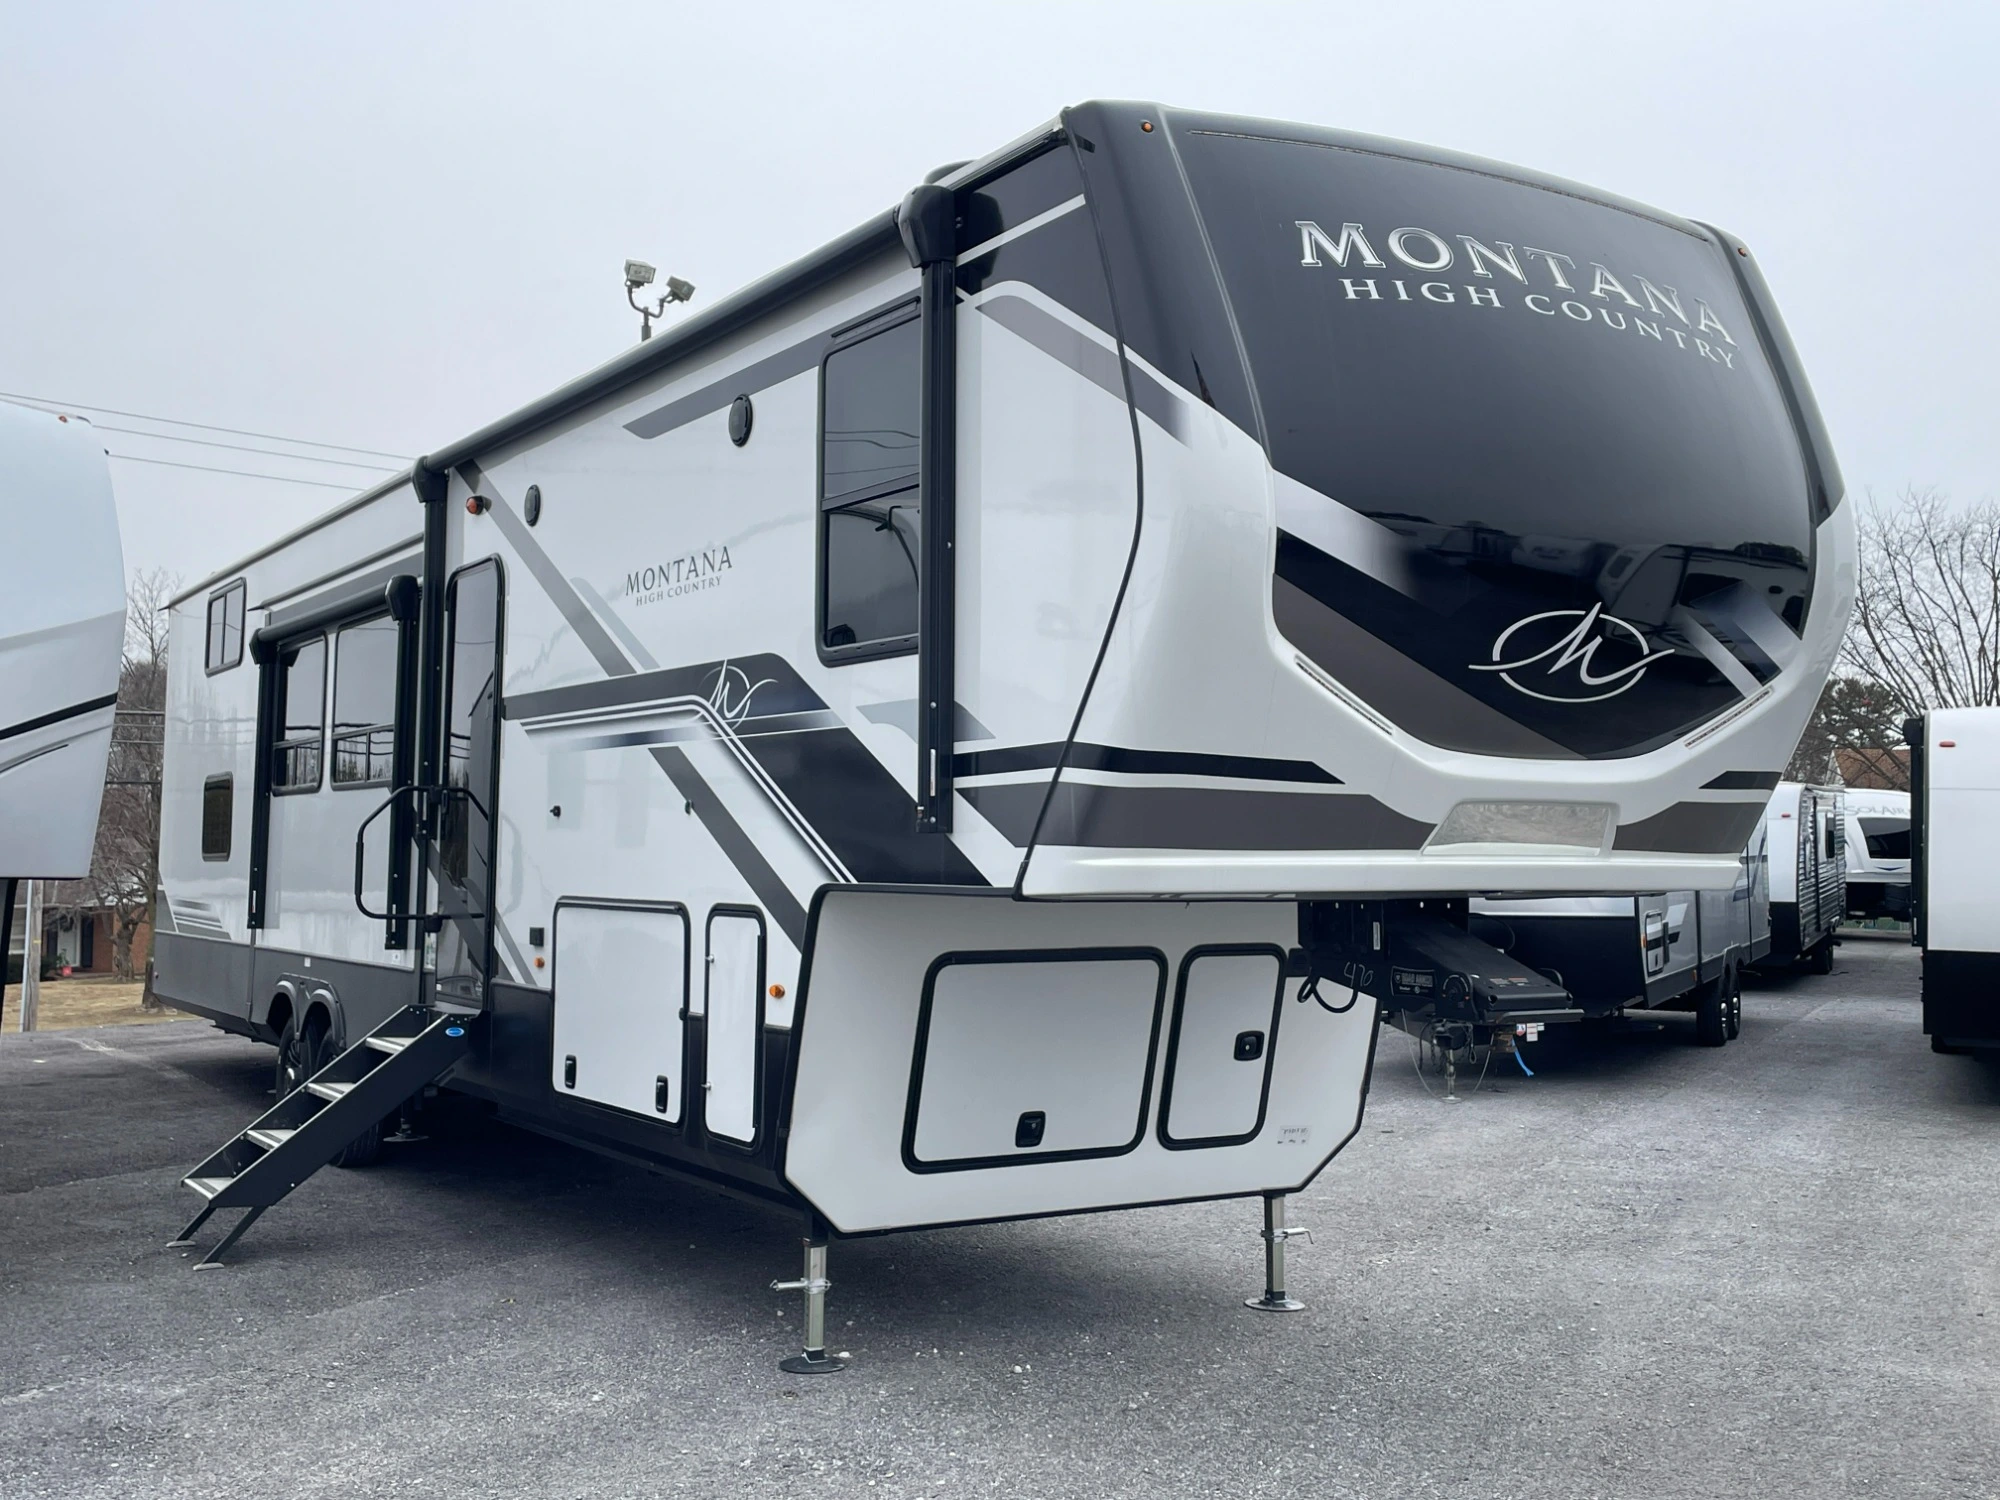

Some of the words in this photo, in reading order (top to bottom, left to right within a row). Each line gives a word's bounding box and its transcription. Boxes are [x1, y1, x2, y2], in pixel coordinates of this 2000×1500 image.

[1294, 220, 1739, 349] MONTANA
[1338, 278, 1505, 308] HIGH
[1524, 294, 1736, 370] COUNTRY
[625, 546, 733, 596] MONTANA
[635, 590, 664, 607] HIGH
[667, 575, 722, 598] COUNTRY
